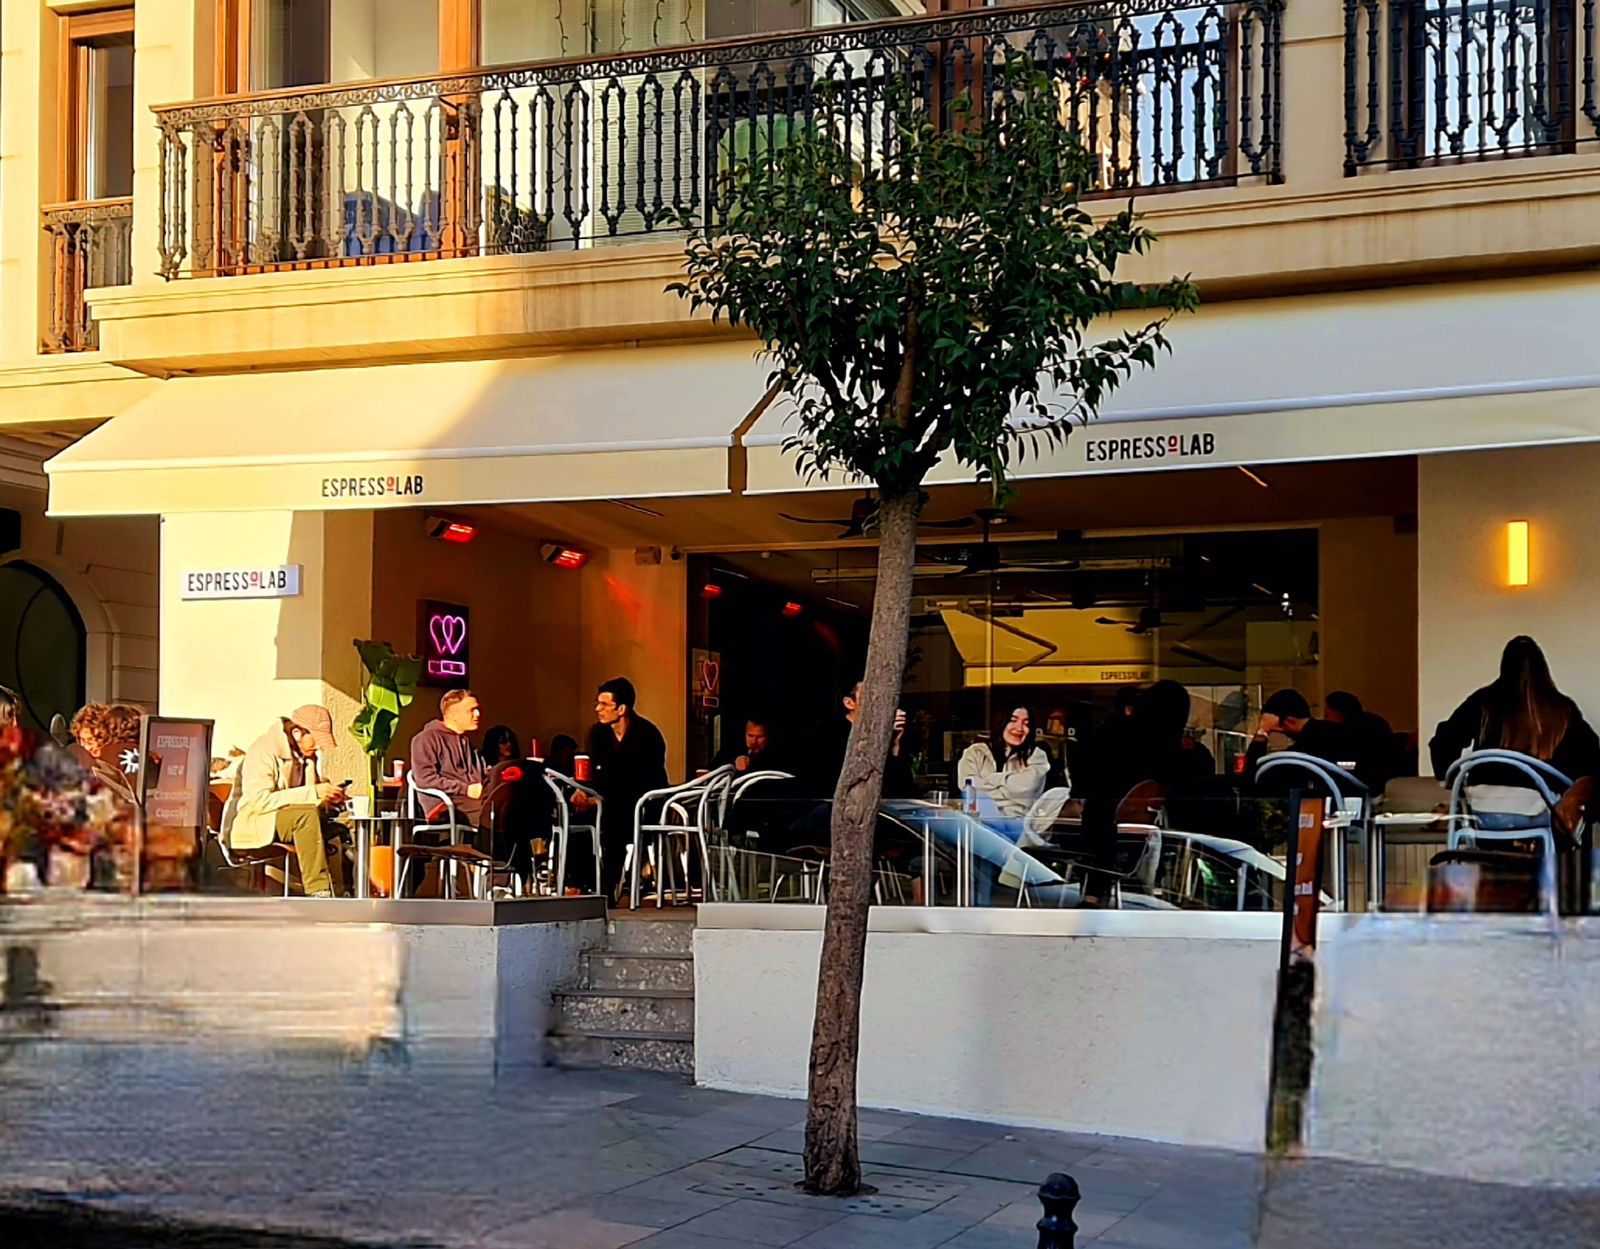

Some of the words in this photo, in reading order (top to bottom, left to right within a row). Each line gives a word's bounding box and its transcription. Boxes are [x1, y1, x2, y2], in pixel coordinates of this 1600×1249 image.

[1086, 433, 1215, 462] ESPRESSOLAB
[322, 475, 423, 497] ESPRESSOLAB
[188, 570, 287, 592] ESPRESSOLAB
